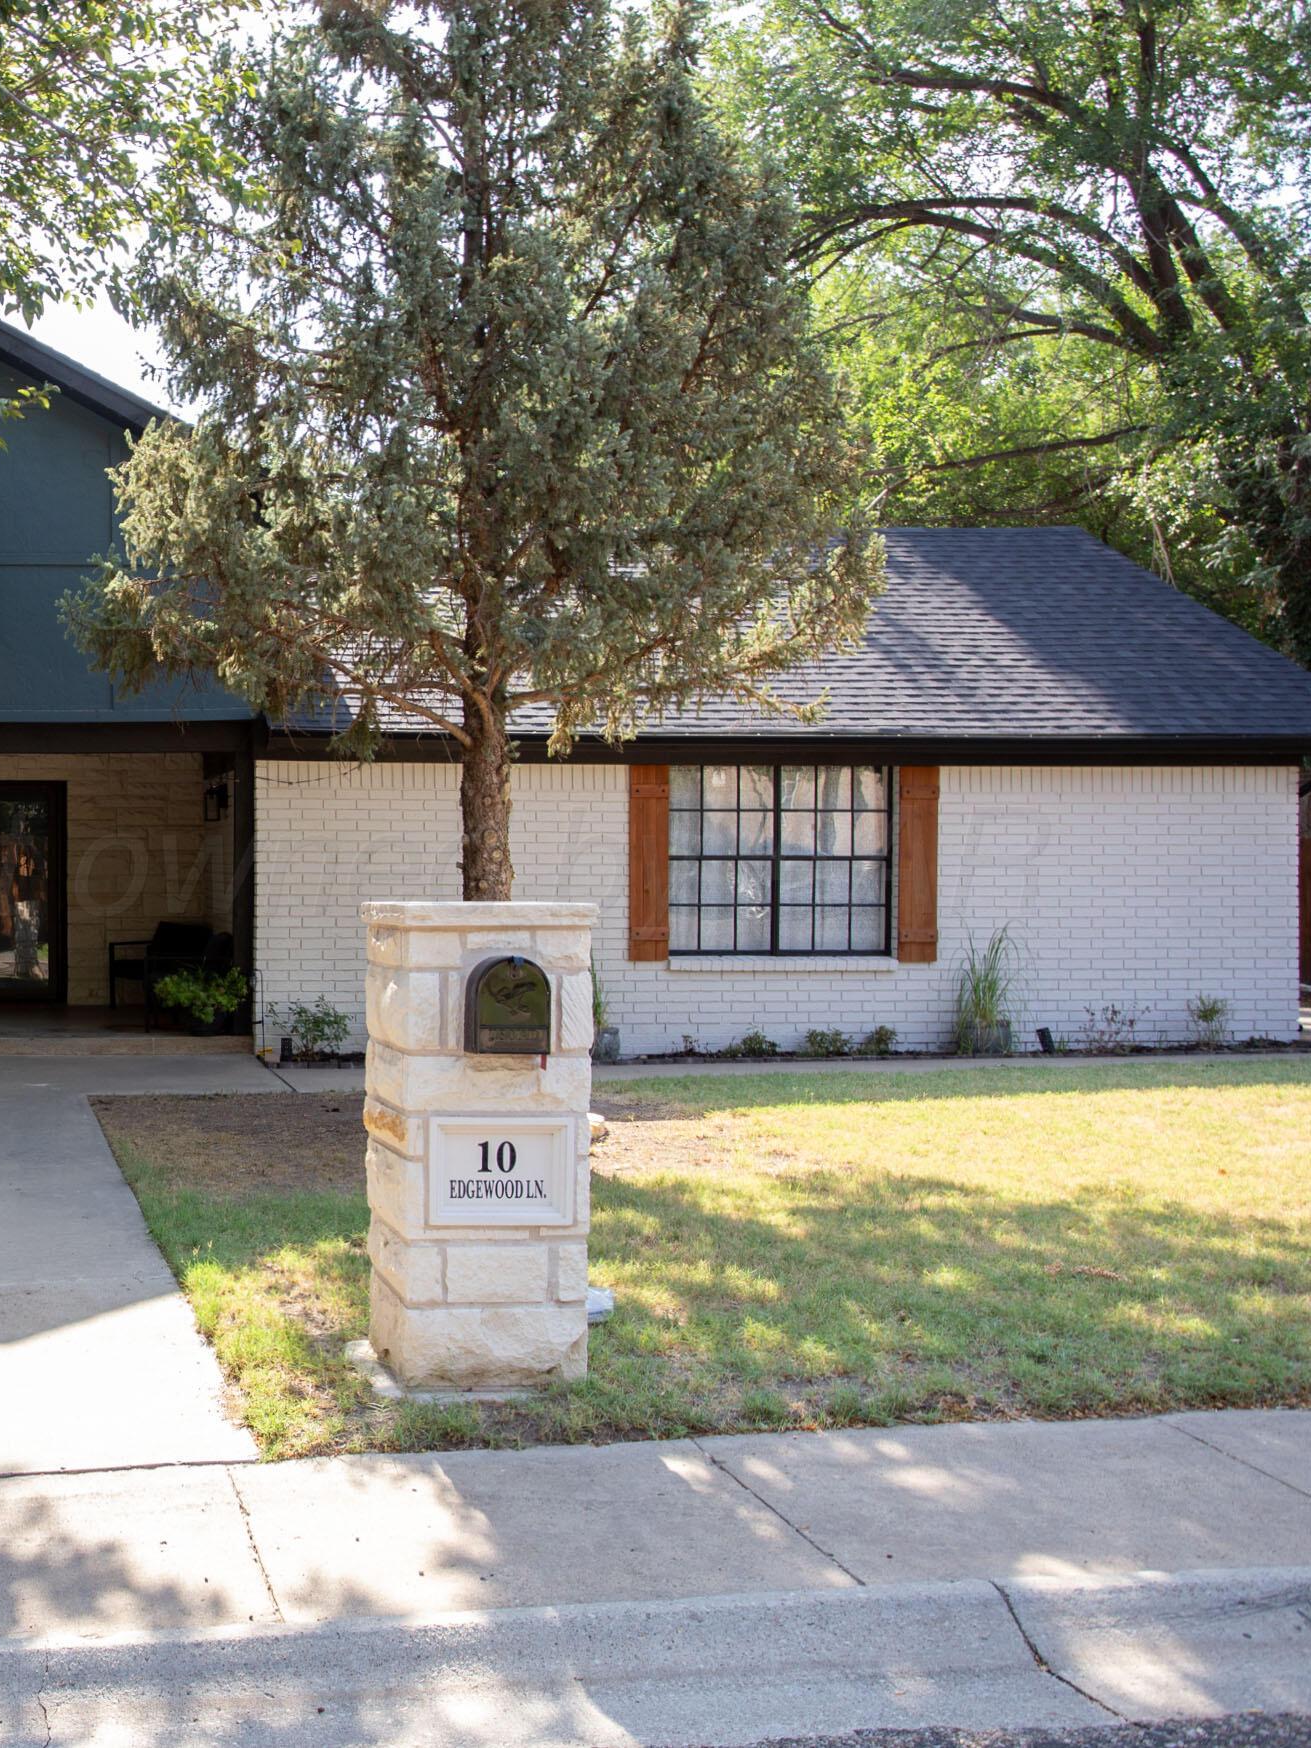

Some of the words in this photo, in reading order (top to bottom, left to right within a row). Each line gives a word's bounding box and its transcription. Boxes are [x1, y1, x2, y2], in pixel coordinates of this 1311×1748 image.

[477, 1140, 517, 1173] 10
[449, 1179, 524, 1199] EDGEWOOD
[526, 1179, 547, 1199] LN.
